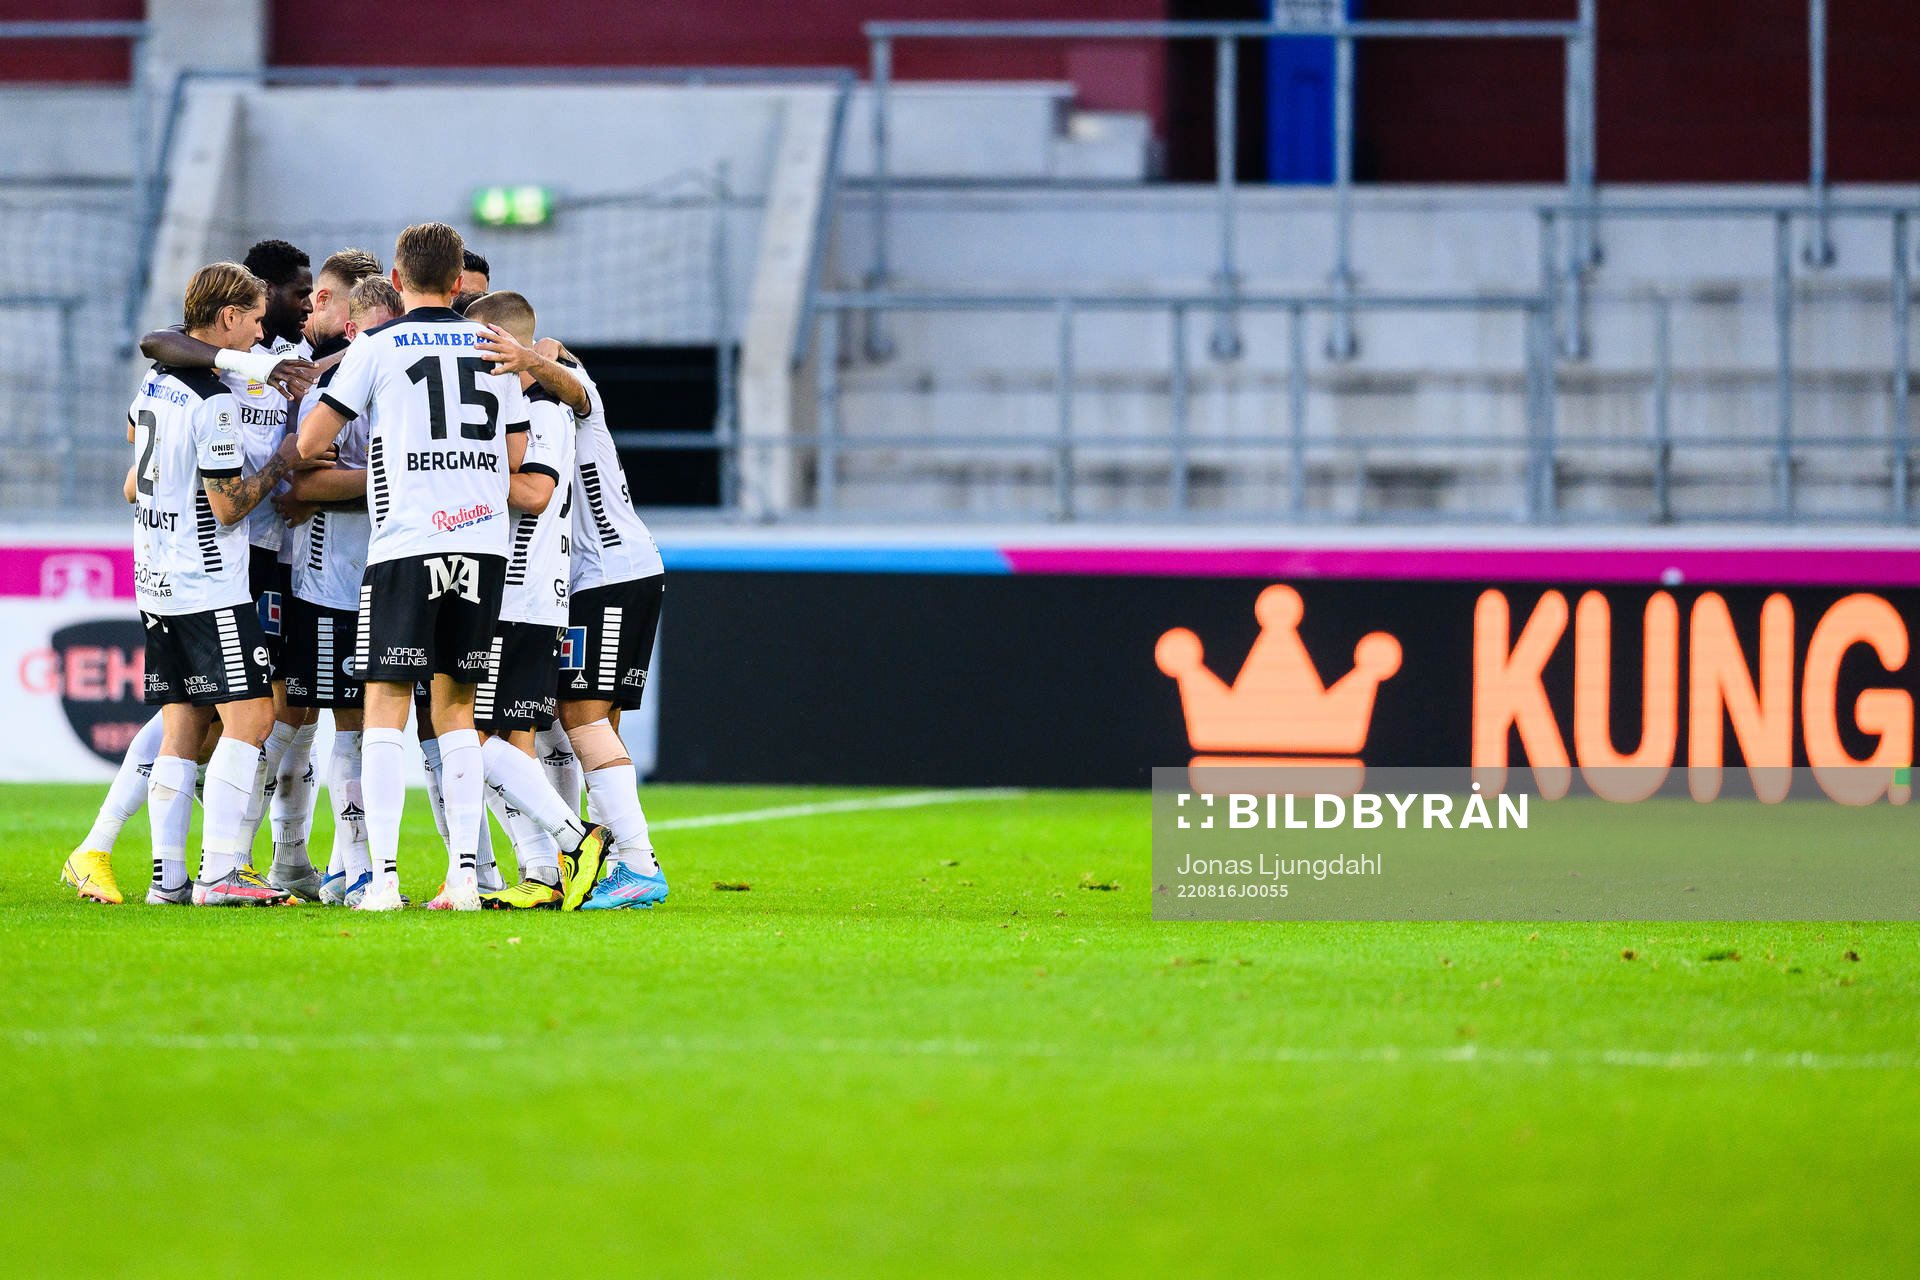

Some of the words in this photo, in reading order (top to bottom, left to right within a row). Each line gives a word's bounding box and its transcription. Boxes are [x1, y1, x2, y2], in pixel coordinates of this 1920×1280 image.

[393, 333, 492, 347] MALMBE
[405, 356, 499, 441] 15
[136, 409, 157, 496] 2
[407, 451, 500, 474] BERGMAR
[387, 647, 425, 657] NORDIC
[467, 651, 491, 661] NORDI
[380, 656, 428, 666] WELLNESS
[458, 659, 491, 670] WELLNE
[261, 673, 268, 684] 2
[344, 687, 358, 698] 27
[1471, 588, 1914, 807] KUNG
